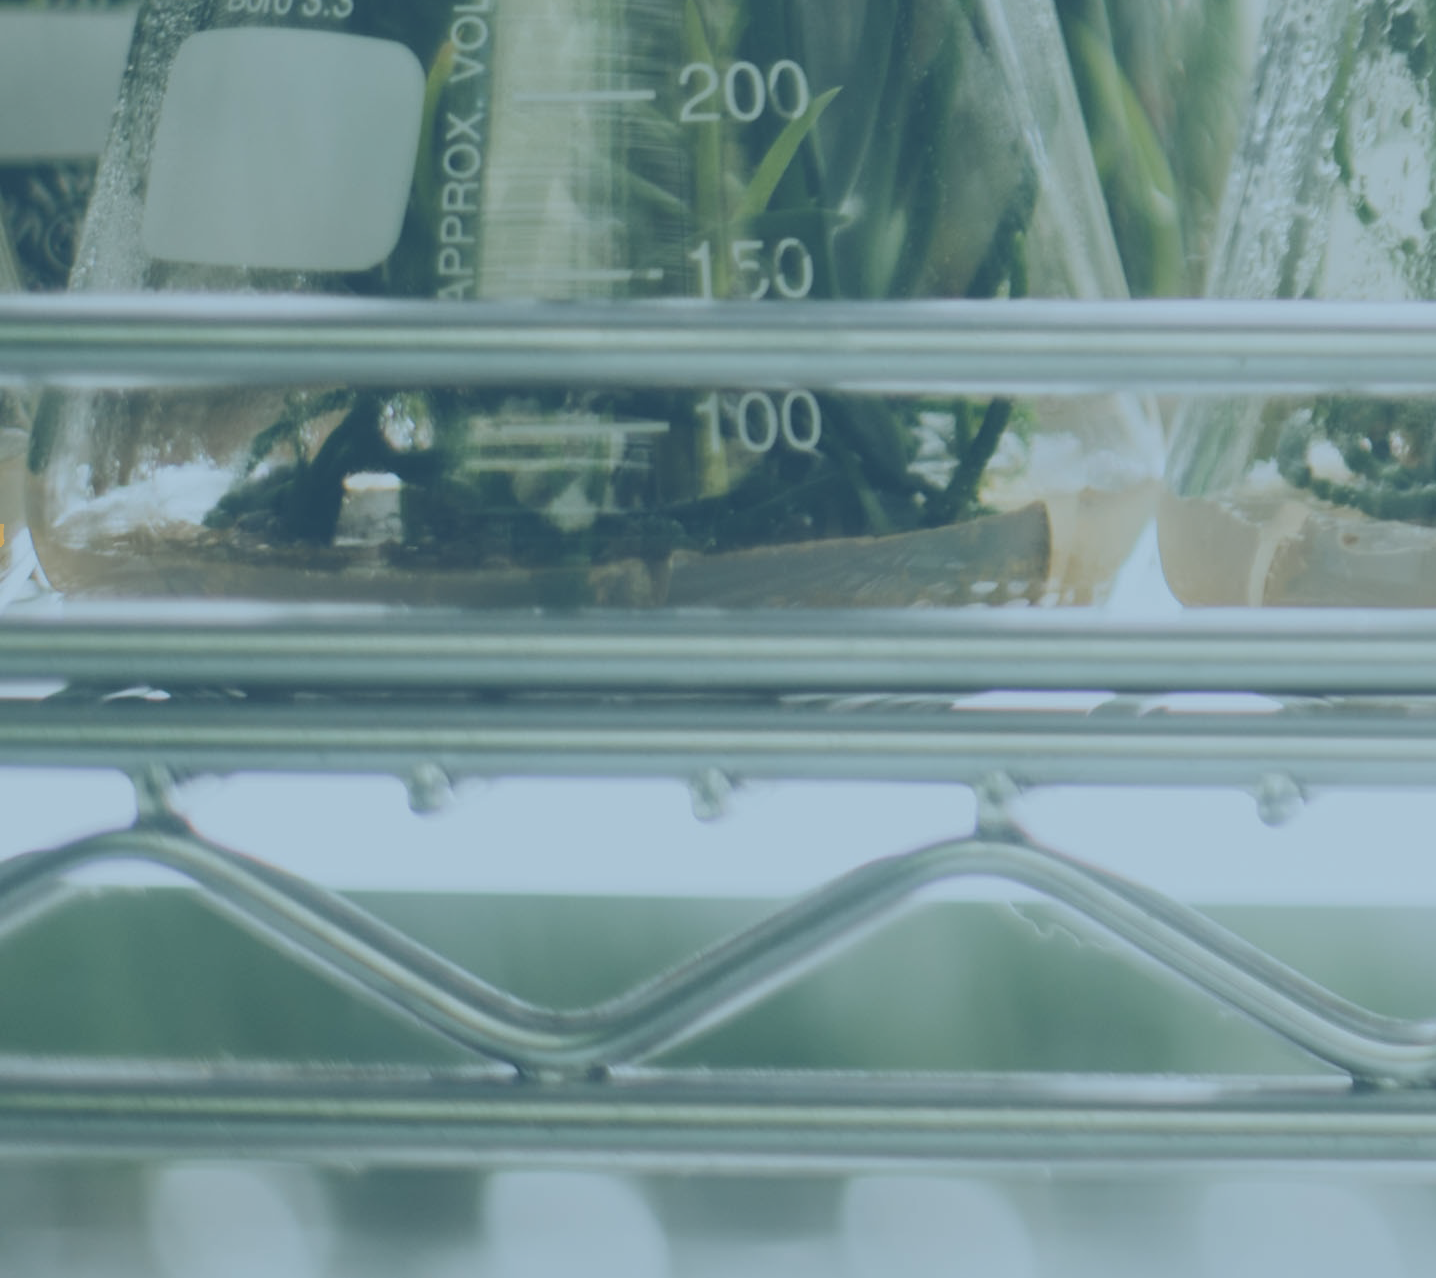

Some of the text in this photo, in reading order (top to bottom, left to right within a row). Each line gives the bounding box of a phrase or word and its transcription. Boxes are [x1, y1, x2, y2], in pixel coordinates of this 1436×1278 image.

[678, 59, 809, 123] 200
[690, 237, 814, 299] 150
[697, 389, 822, 452] 100
